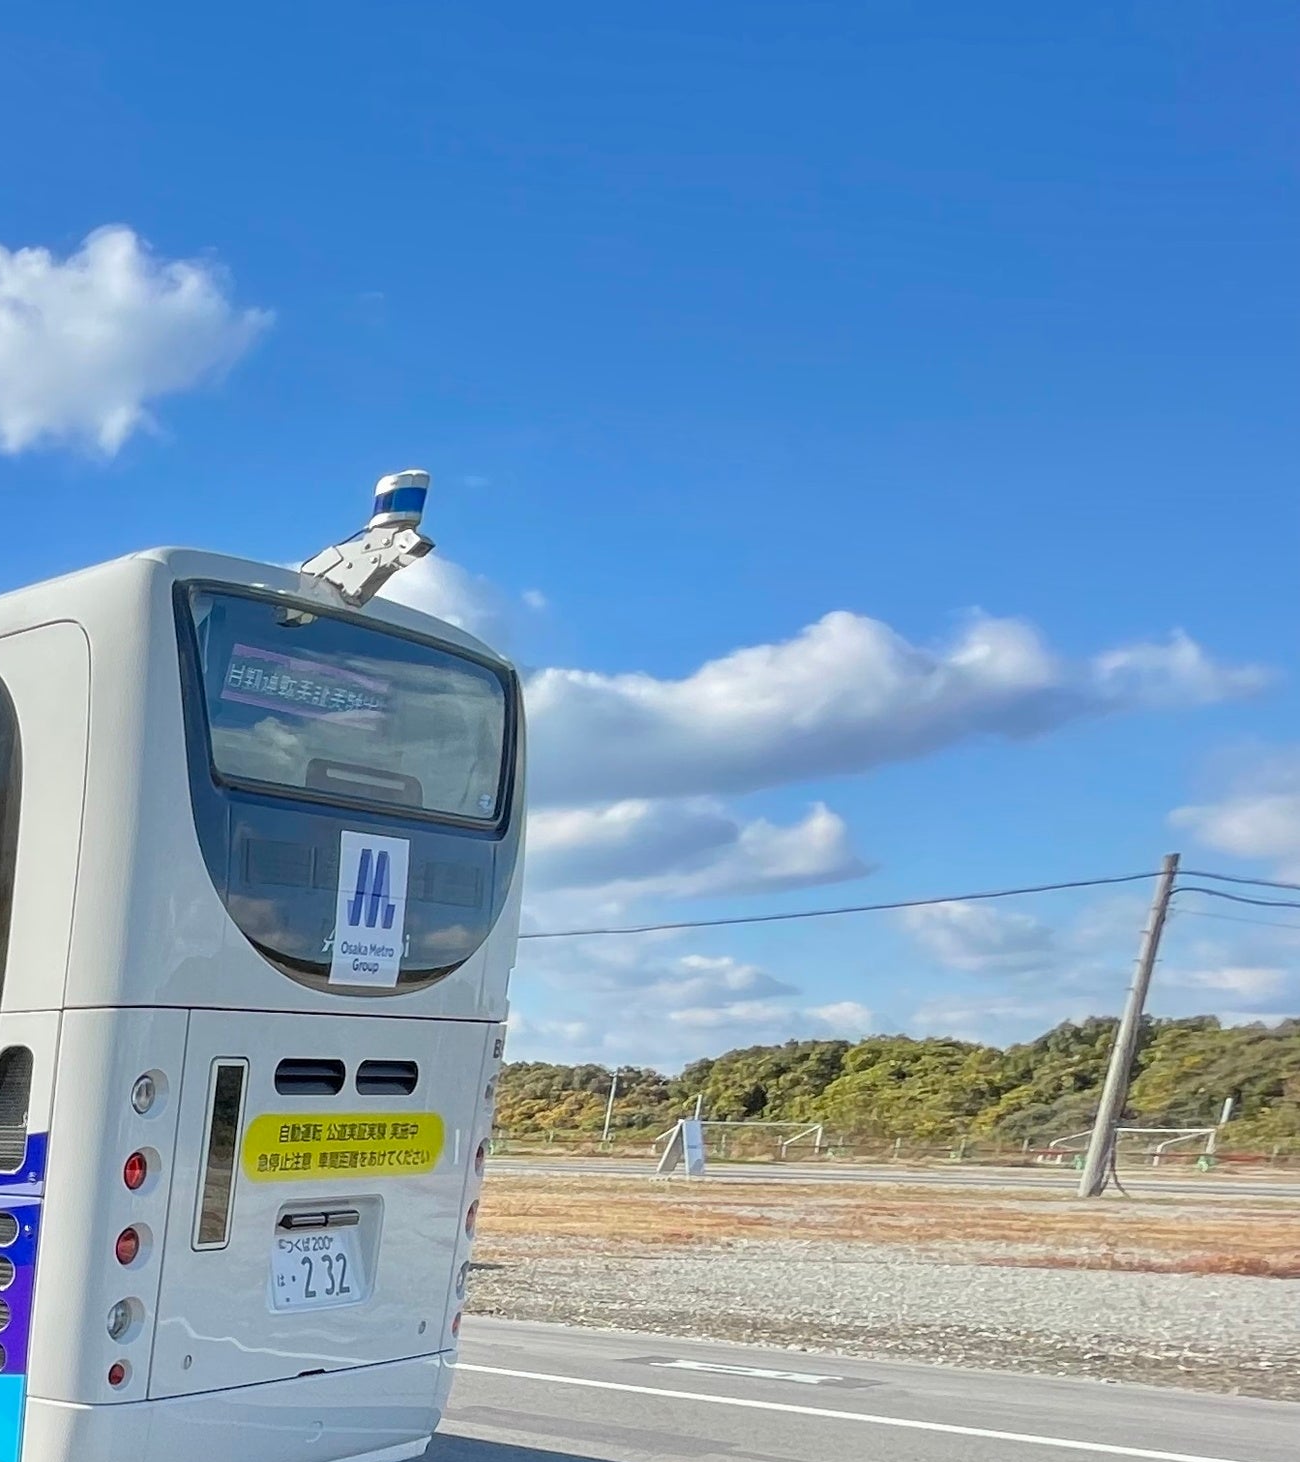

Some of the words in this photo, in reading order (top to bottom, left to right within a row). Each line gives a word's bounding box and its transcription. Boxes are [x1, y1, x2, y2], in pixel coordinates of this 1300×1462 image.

[340, 940, 368, 956] Osaka
[369, 943, 394, 958] Metro
[352, 958, 379, 973] Group
